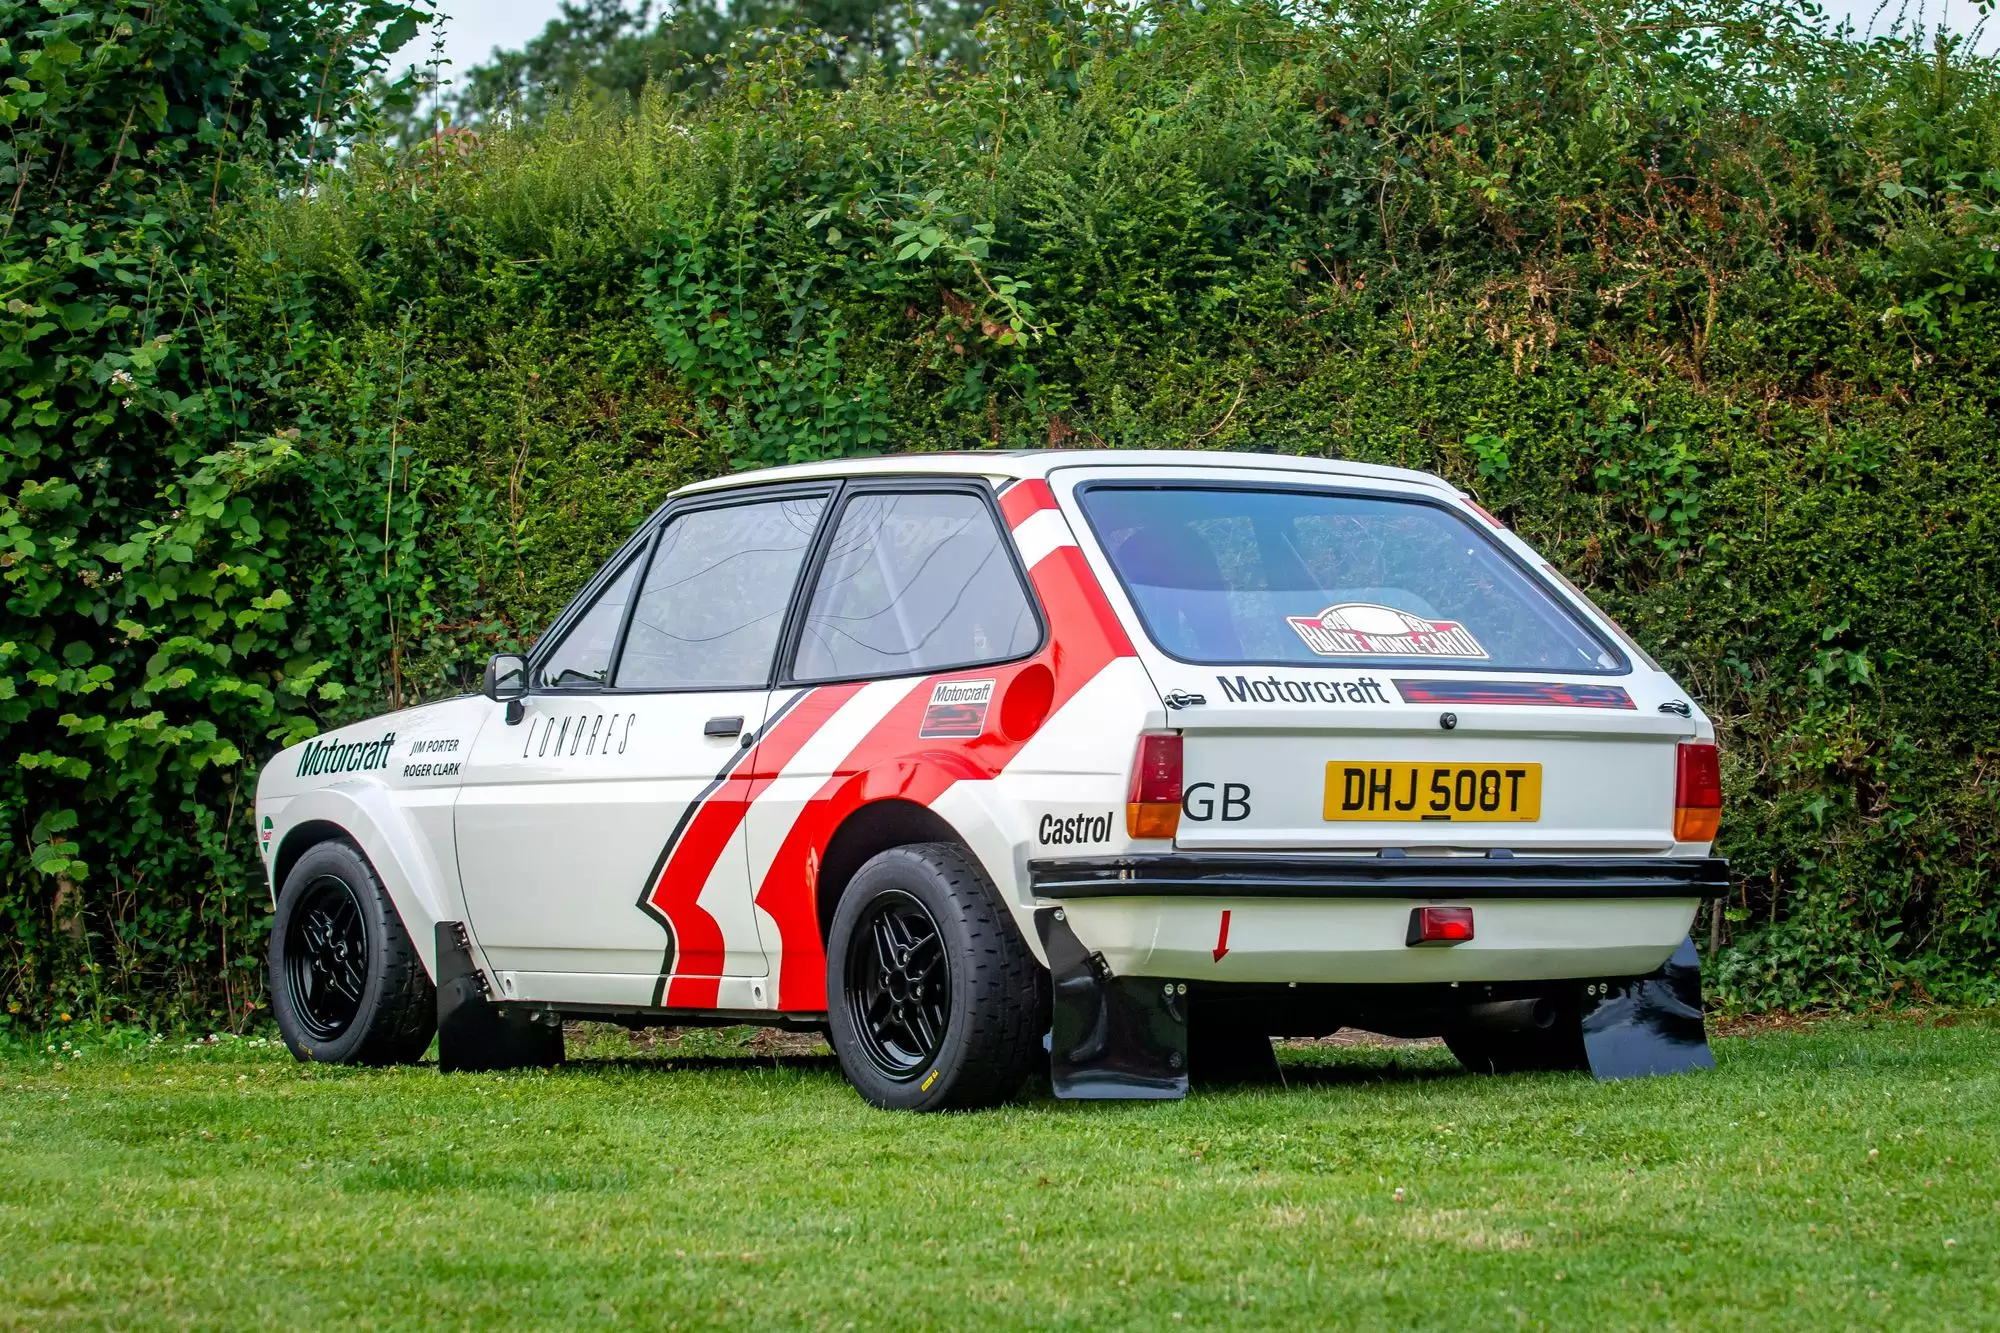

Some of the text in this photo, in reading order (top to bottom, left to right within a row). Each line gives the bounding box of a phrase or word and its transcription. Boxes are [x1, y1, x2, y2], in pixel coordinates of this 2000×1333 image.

[1296, 623, 1367, 652] RALLYE
[934, 684, 991, 702] Motorcraft
[1216, 676, 1390, 704] Motorcraft
[409, 739, 459, 756] JIM PORTER
[523, 713, 635, 758] LONDRES
[296, 733, 395, 777] Motorcraft
[403, 763, 459, 777] ROGER CLARK
[1182, 782, 1252, 822] GB
[1342, 768, 1526, 812] DHJ 508T
[1038, 812, 1113, 845] Castrol
